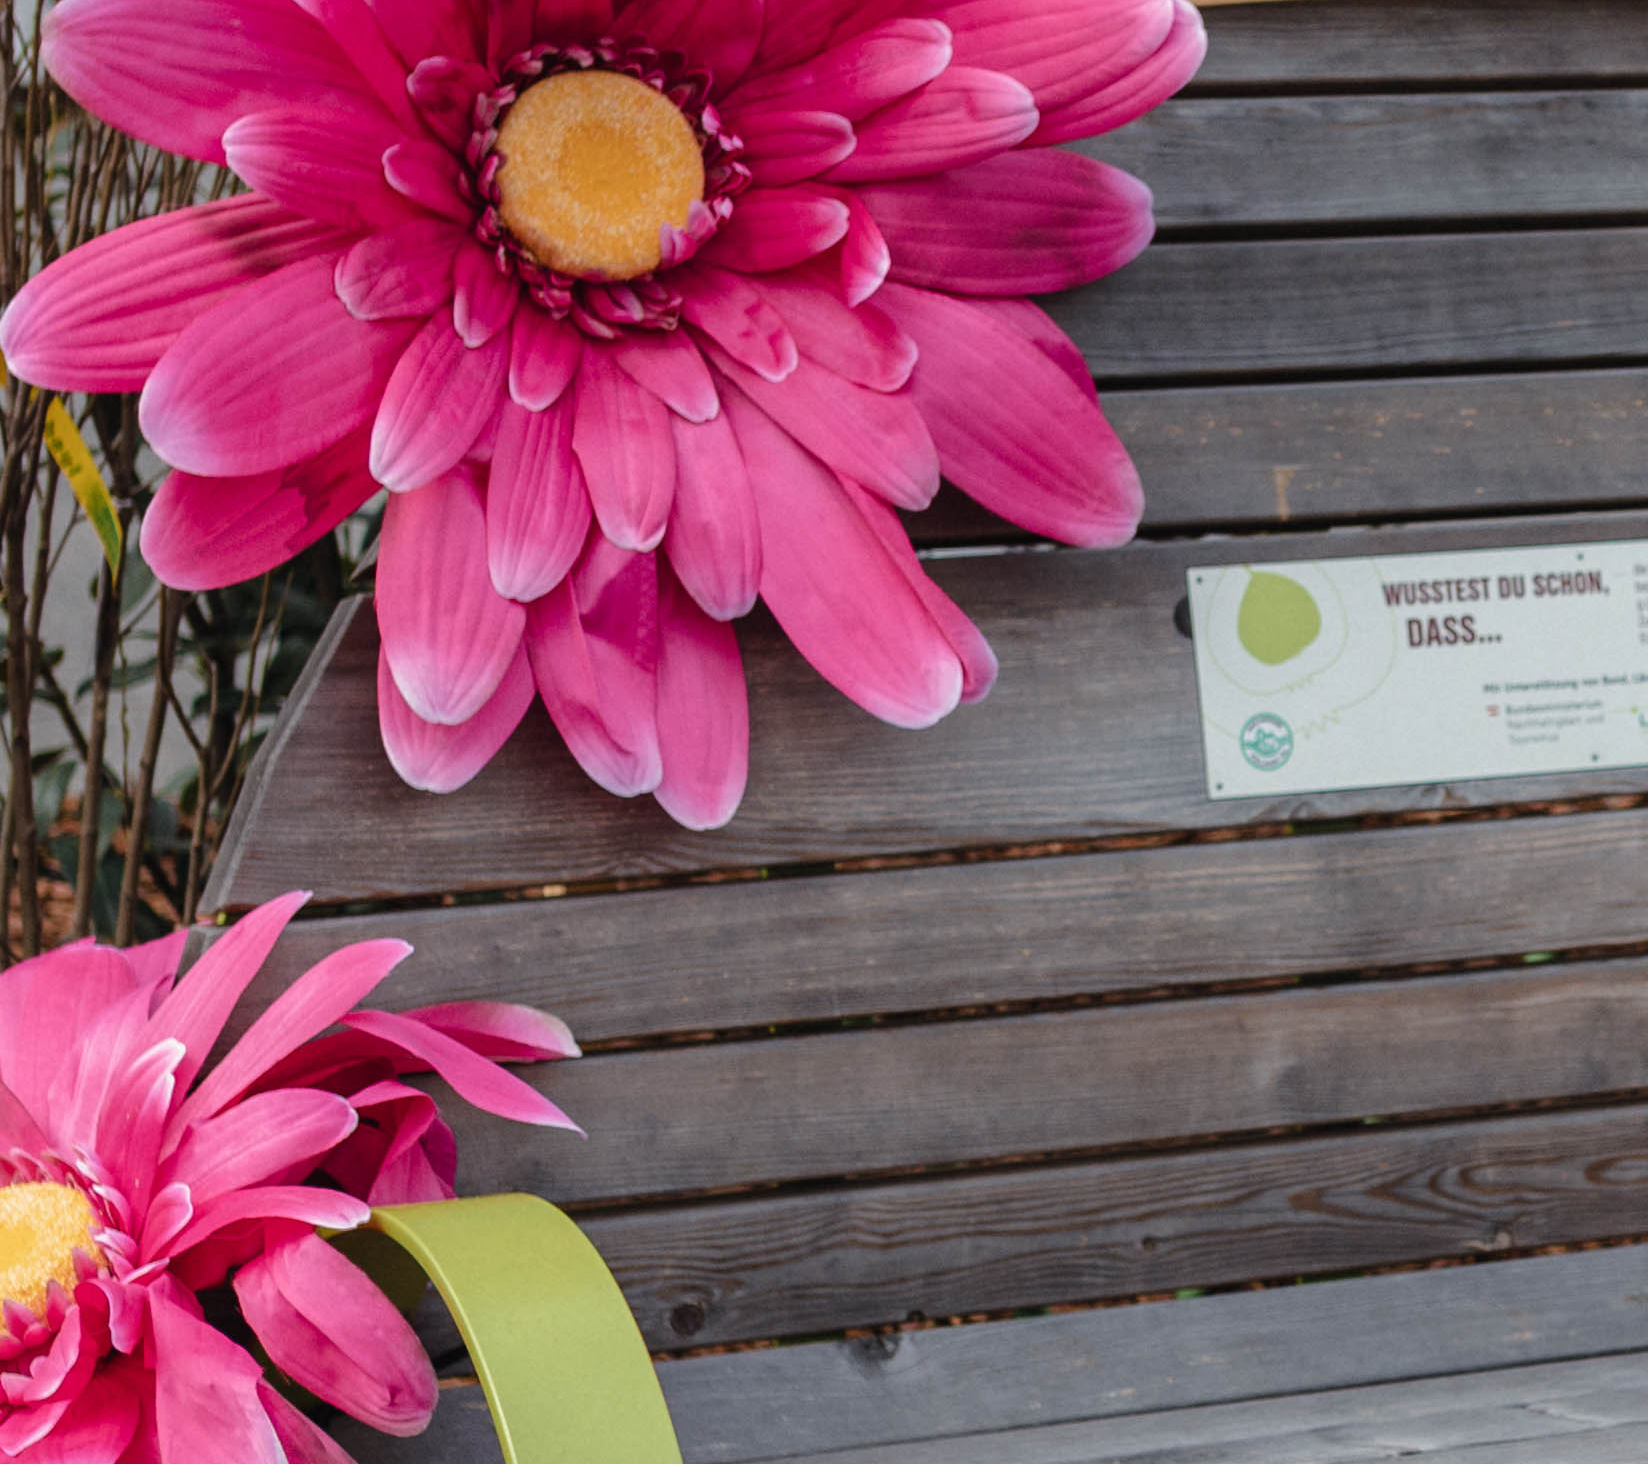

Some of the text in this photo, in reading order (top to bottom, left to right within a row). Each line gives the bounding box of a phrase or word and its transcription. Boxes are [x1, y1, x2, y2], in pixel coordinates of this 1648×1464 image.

[1382, 578, 1490, 607] WUSSTEST
[1498, 575, 1525, 599] DU
[1407, 616, 1503, 647] DASS...
